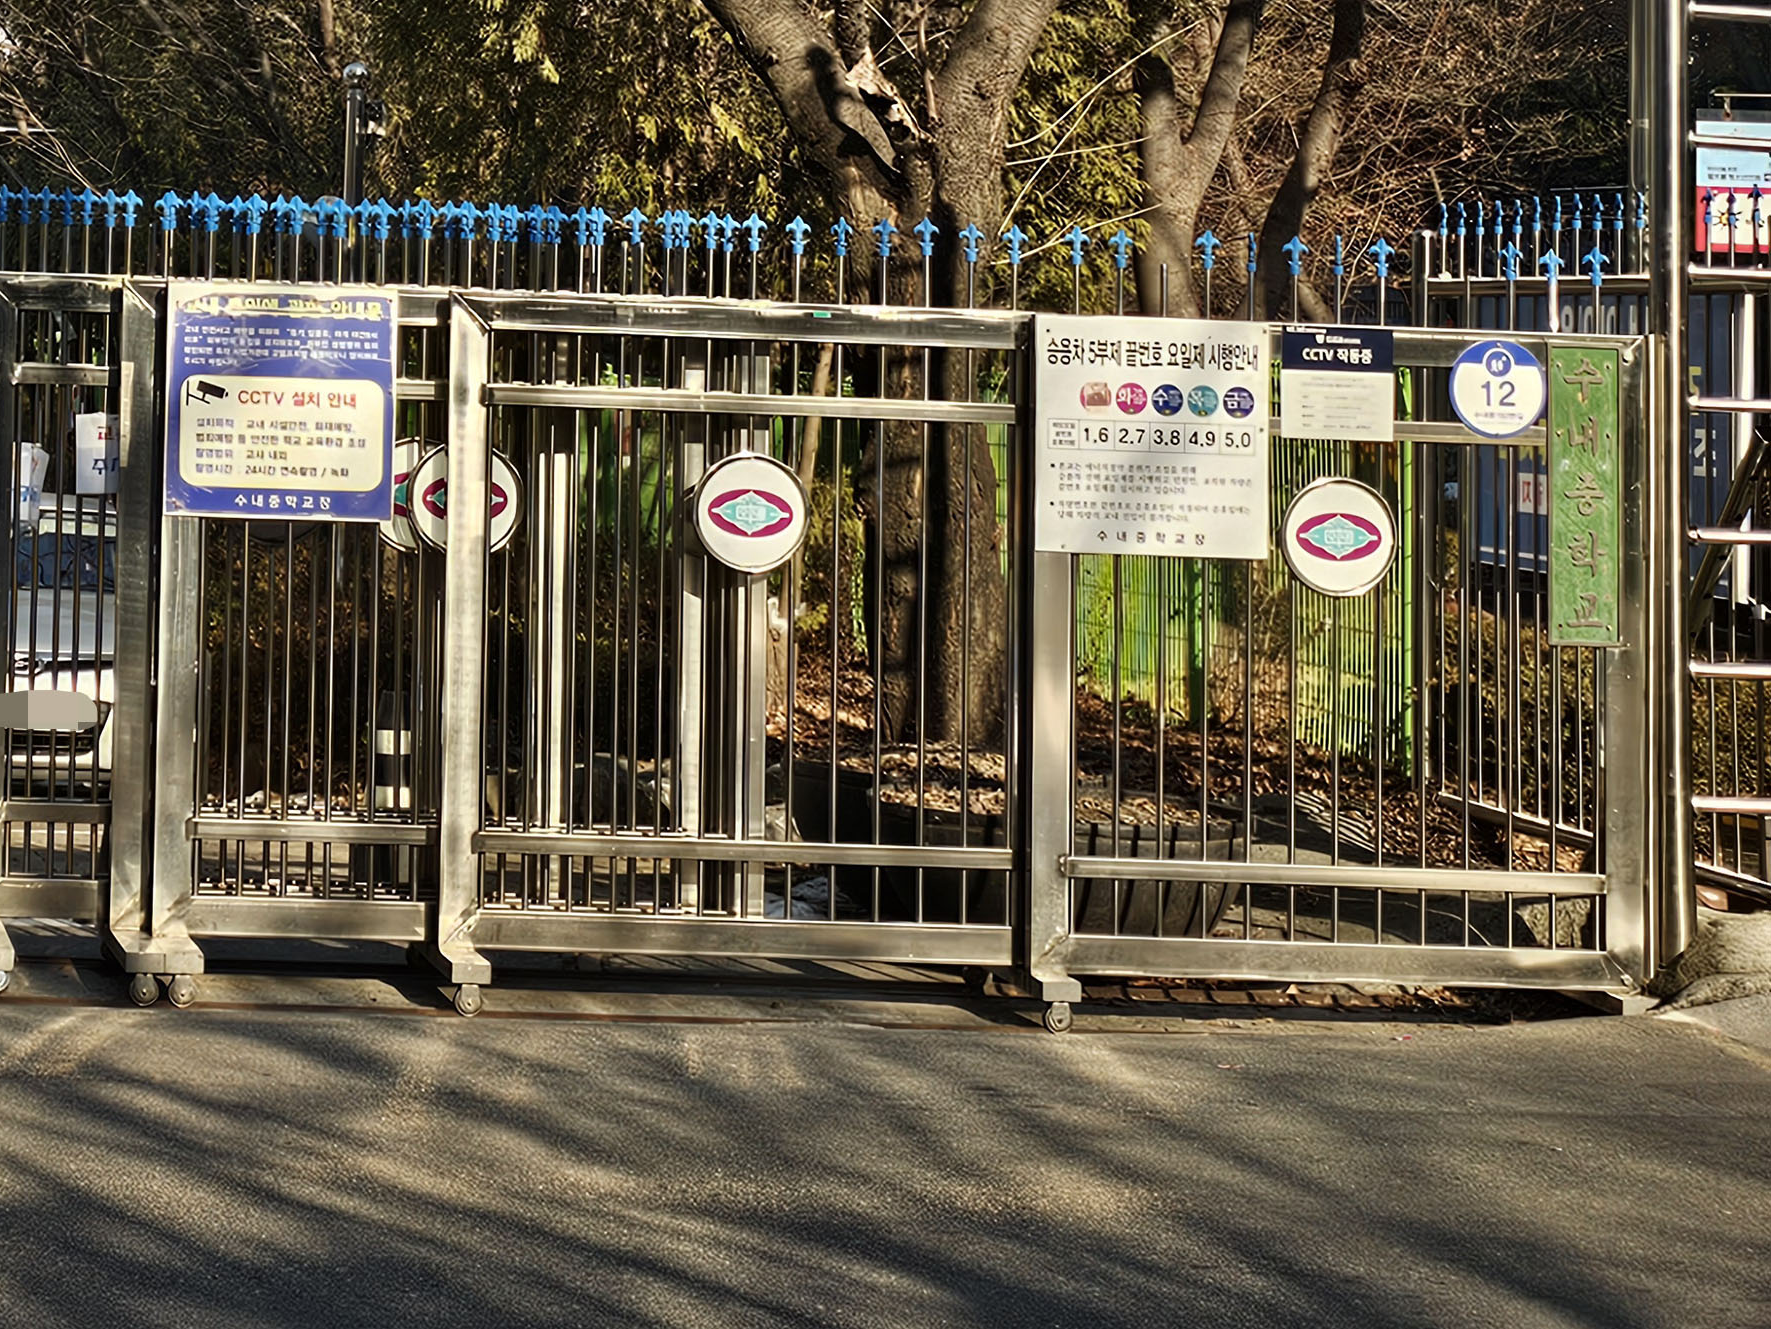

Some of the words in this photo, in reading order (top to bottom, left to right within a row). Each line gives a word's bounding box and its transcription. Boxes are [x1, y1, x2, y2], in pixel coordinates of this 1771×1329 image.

[1046, 338, 1085, 366] 승용차
[1088, 340, 1122, 366] 5부제
[1125, 341, 1163, 368] 끝번호
[1167, 342, 1205, 370] 요일제
[1208, 344, 1259, 371] 시행안내
[1302, 347, 1334, 361] CCTV
[1337, 348, 1373, 364] 작동중
[238, 390, 284, 405] CCTV
[292, 391, 321, 408] 설치
[328, 392, 357, 409] 안내
[1153, 389, 1168, 406] 수
[1224, 392, 1239, 409] 금
[1481, 381, 1516, 406] 12
[1083, 427, 1109, 444] 1.6
[1119, 428, 1145, 444] 2.7
[1153, 429, 1180, 446] 3.8
[1189, 431, 1216, 447] 4.9
[1225, 432, 1251, 448] 5.0
[245, 465, 276, 475] 24시간
[1563, 357, 1607, 629] 수내중학교
